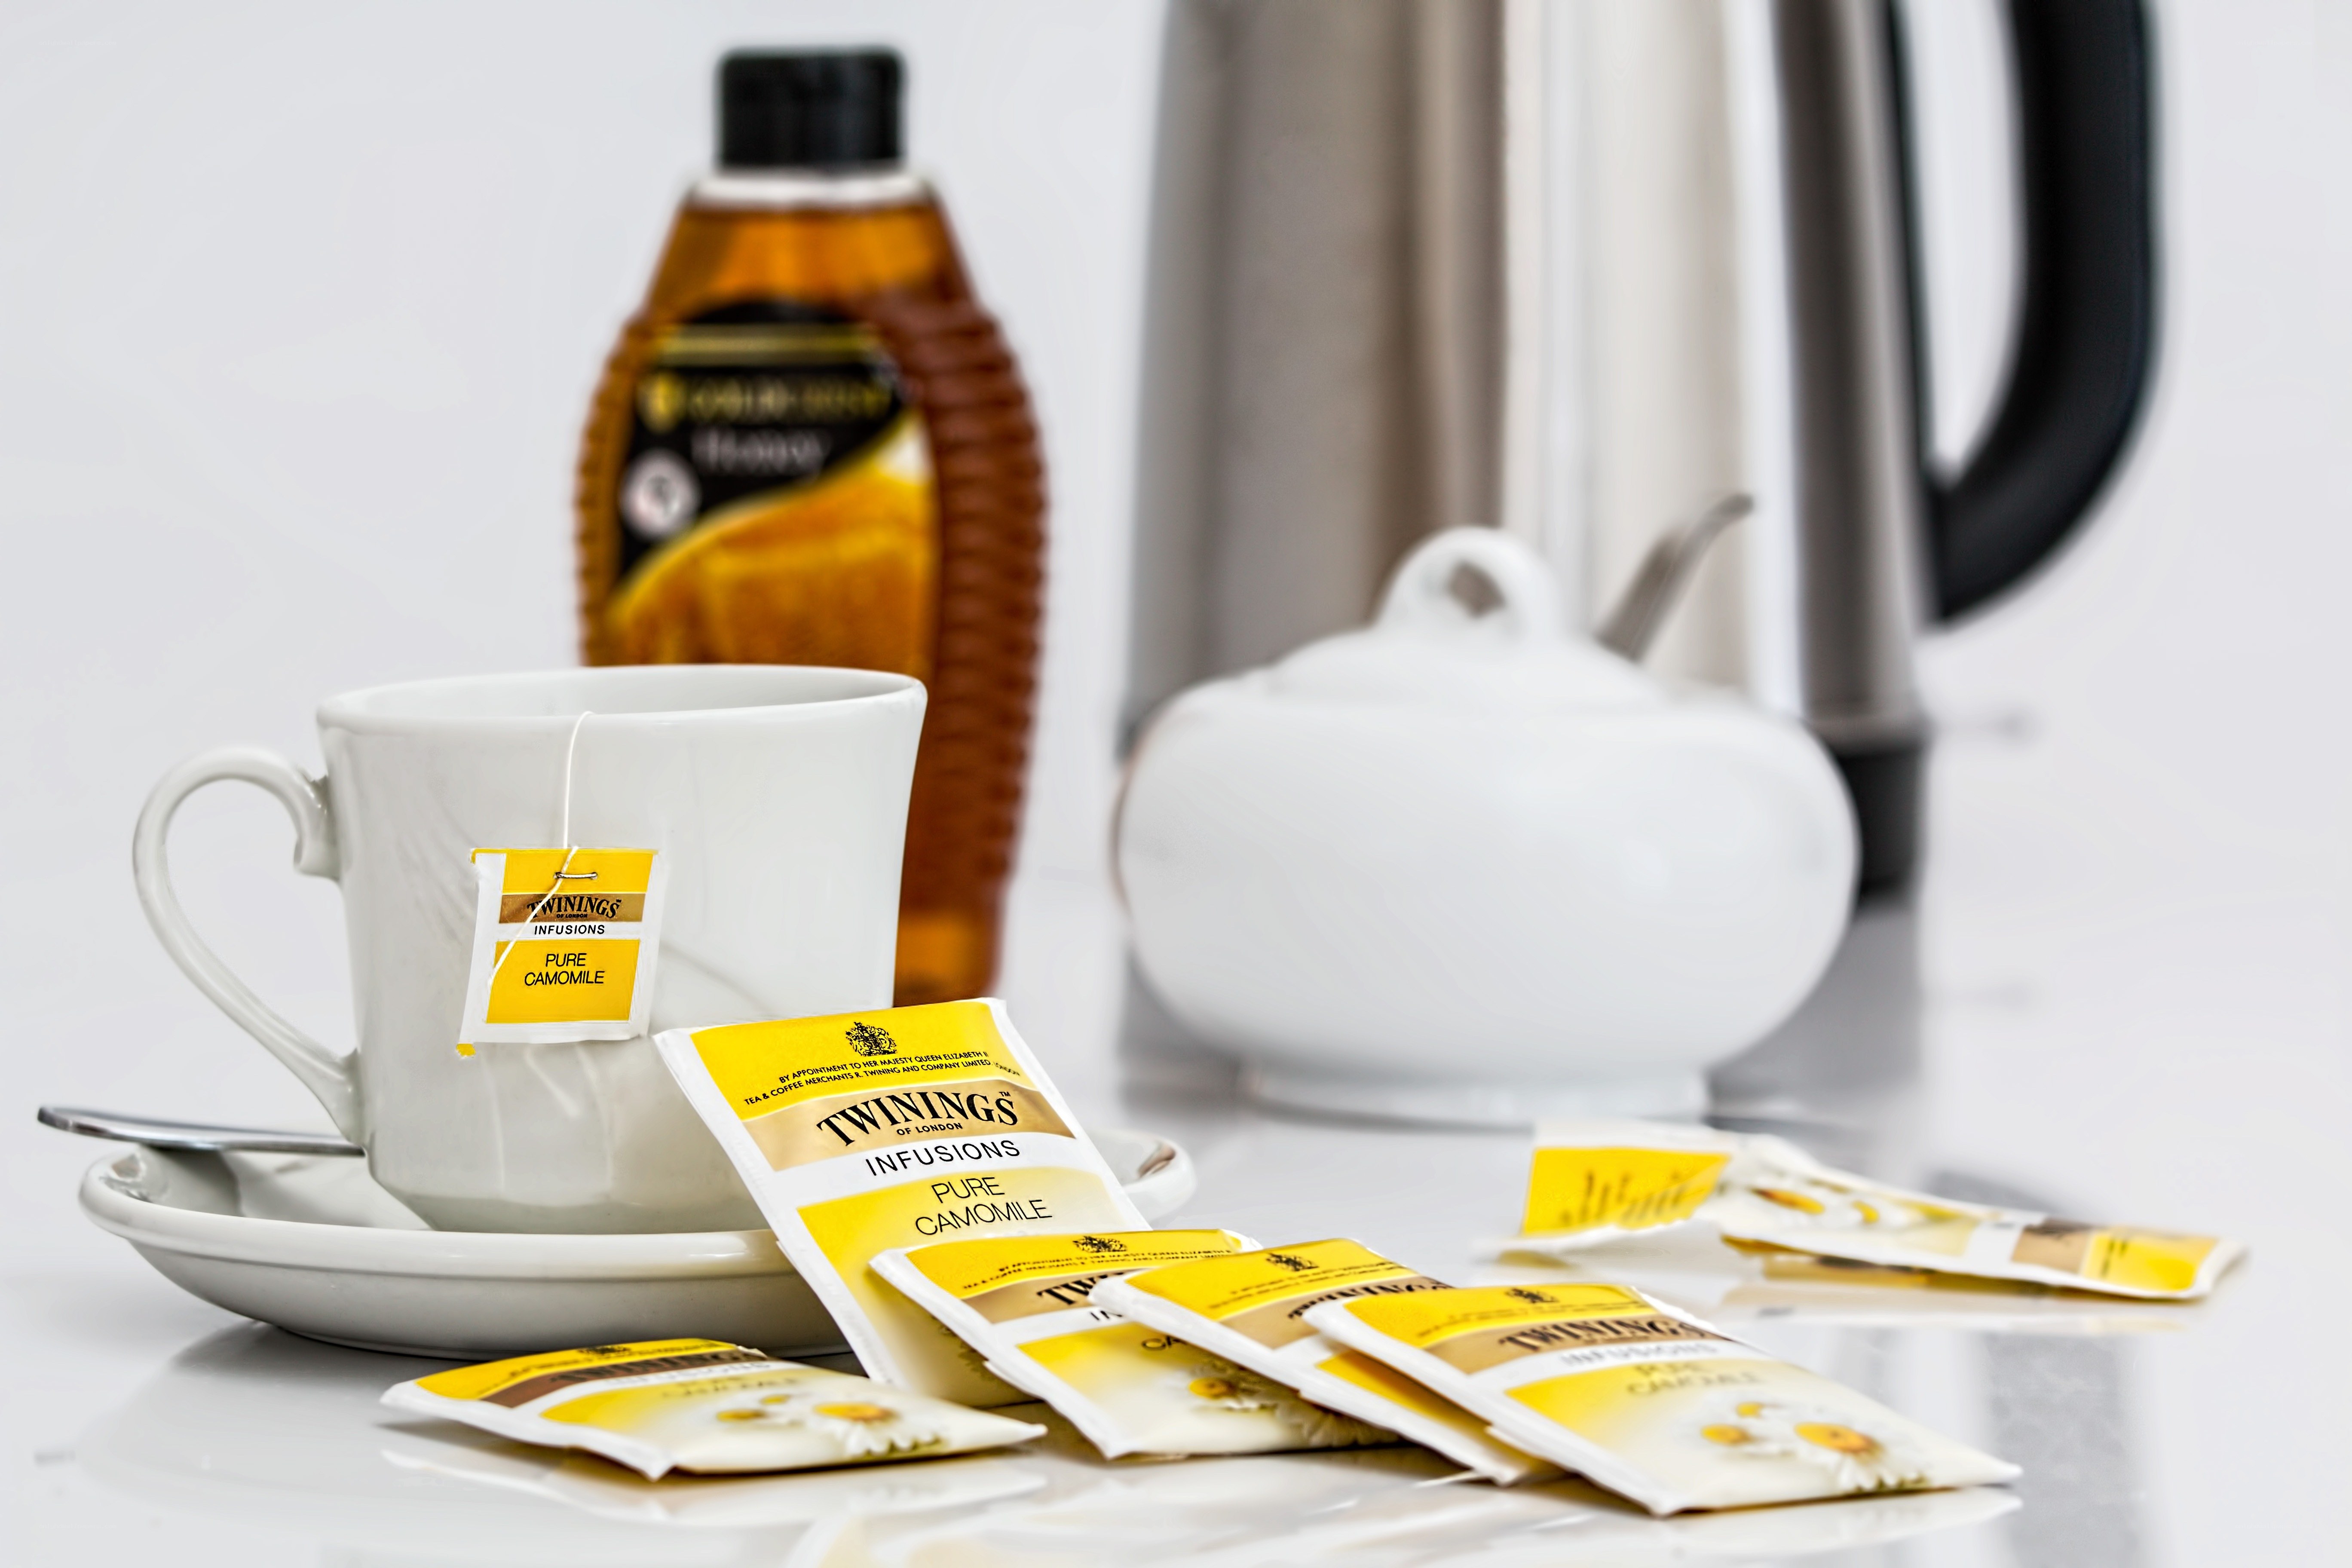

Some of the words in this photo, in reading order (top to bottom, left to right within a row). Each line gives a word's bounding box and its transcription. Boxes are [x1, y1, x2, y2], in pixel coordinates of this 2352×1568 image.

[527, 896, 619, 919] TWININGS
[534, 925, 605, 935] INFUSIONS
[545, 952, 587, 967] PURE
[524, 971, 605, 986] CAMOMILE
[779, 1075, 790, 1083] BY
[793, 1064, 848, 1079] APPOINTMENT
[880, 1057, 913, 1066] MAJESTY
[915, 1055, 943, 1063] QUEEN
[943, 1051, 983, 1060] ELIZABETH
[744, 1096, 762, 1105] TEA
[771, 1081, 804, 1096] COFFEE
[805, 1072, 854, 1086] MERCHANTS
[864, 1067, 900, 1077] TWINING
[921, 1062, 961, 1072] COMPANY
[816, 1091, 1018, 1146] TWININGS
[896, 1127, 912, 1135] OF
[916, 1122, 963, 1133] LONDON
[865, 1139, 1020, 1176] INFUSIONS
[931, 1176, 1005, 1204] PURE
[915, 1199, 1053, 1236] CAMOMILE
